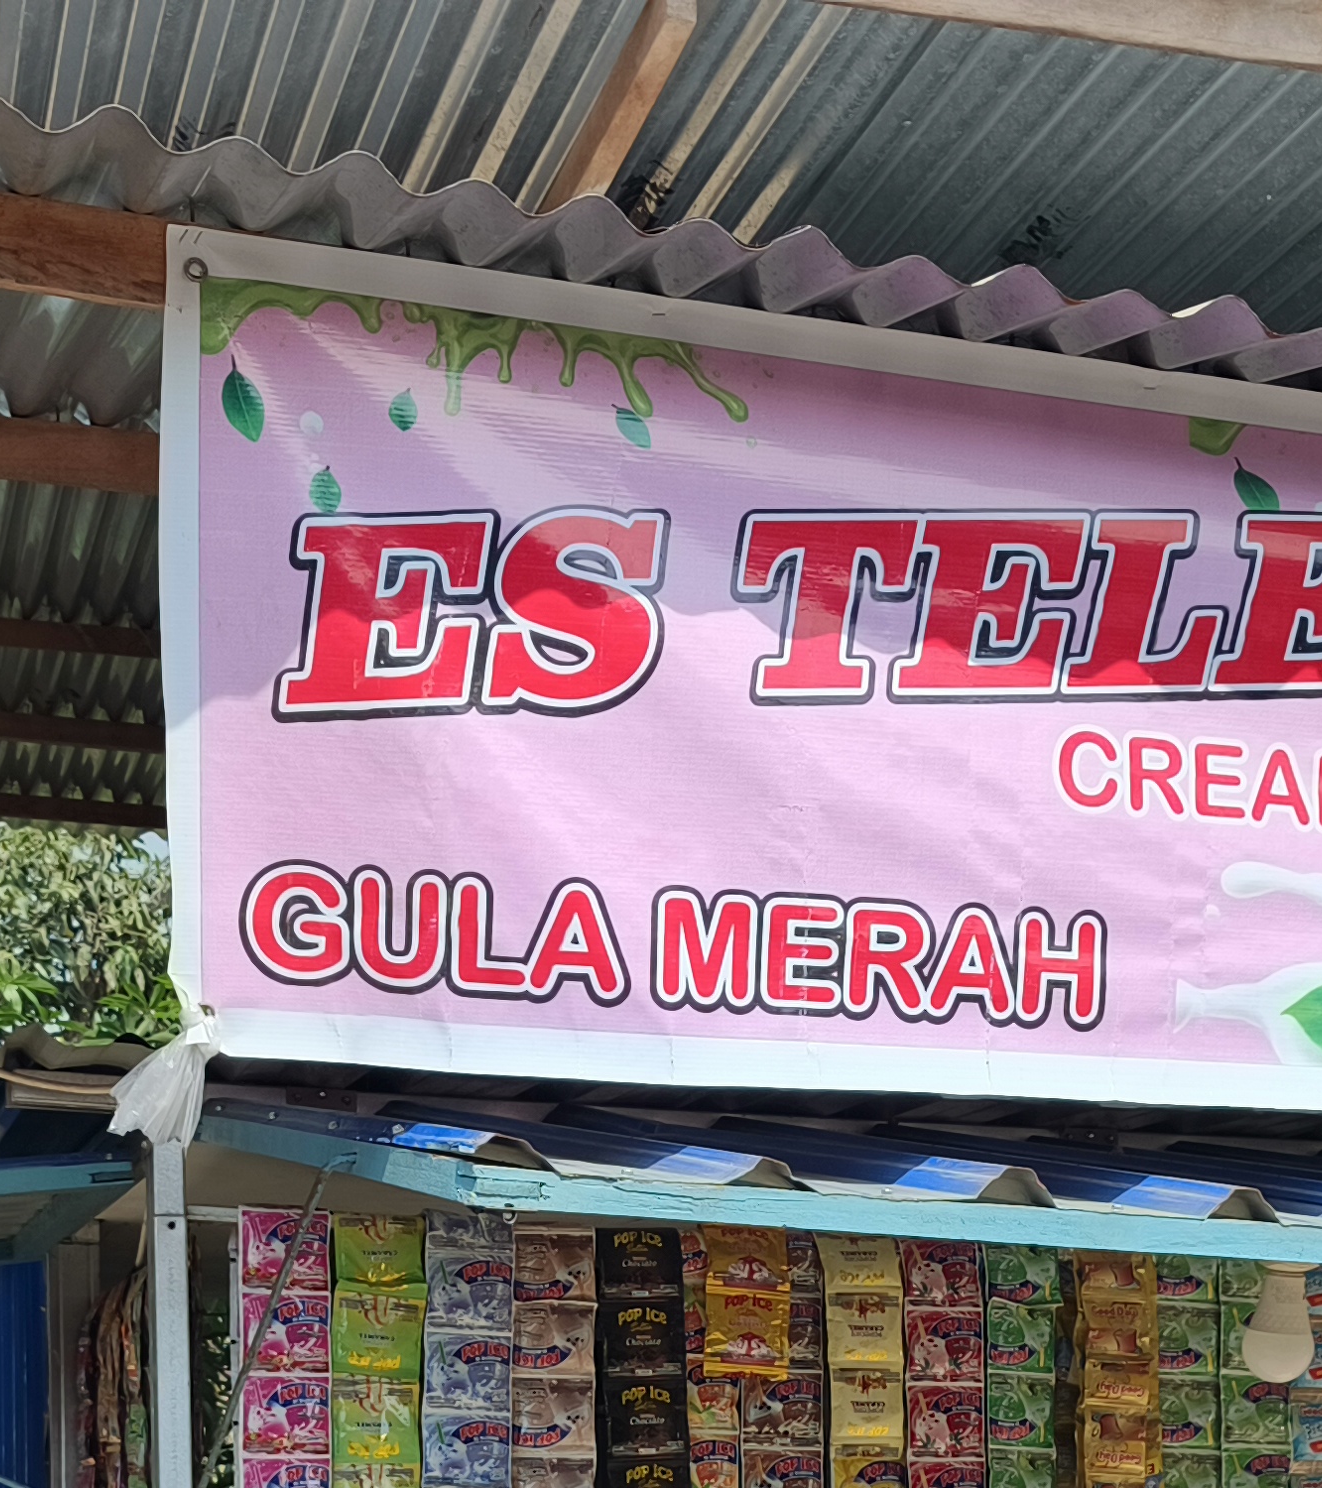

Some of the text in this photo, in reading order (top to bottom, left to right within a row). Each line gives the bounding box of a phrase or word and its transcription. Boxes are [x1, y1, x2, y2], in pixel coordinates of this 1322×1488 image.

[273, 506, 670, 722] ES
[239, 859, 1106, 1030] GULA MERAH
[614, 1231, 639, 1247] POP
[725, 1295, 750, 1310] POP
[618, 1310, 643, 1325] POP
[622, 1388, 647, 1404] POP
[626, 1466, 650, 1483] POP
